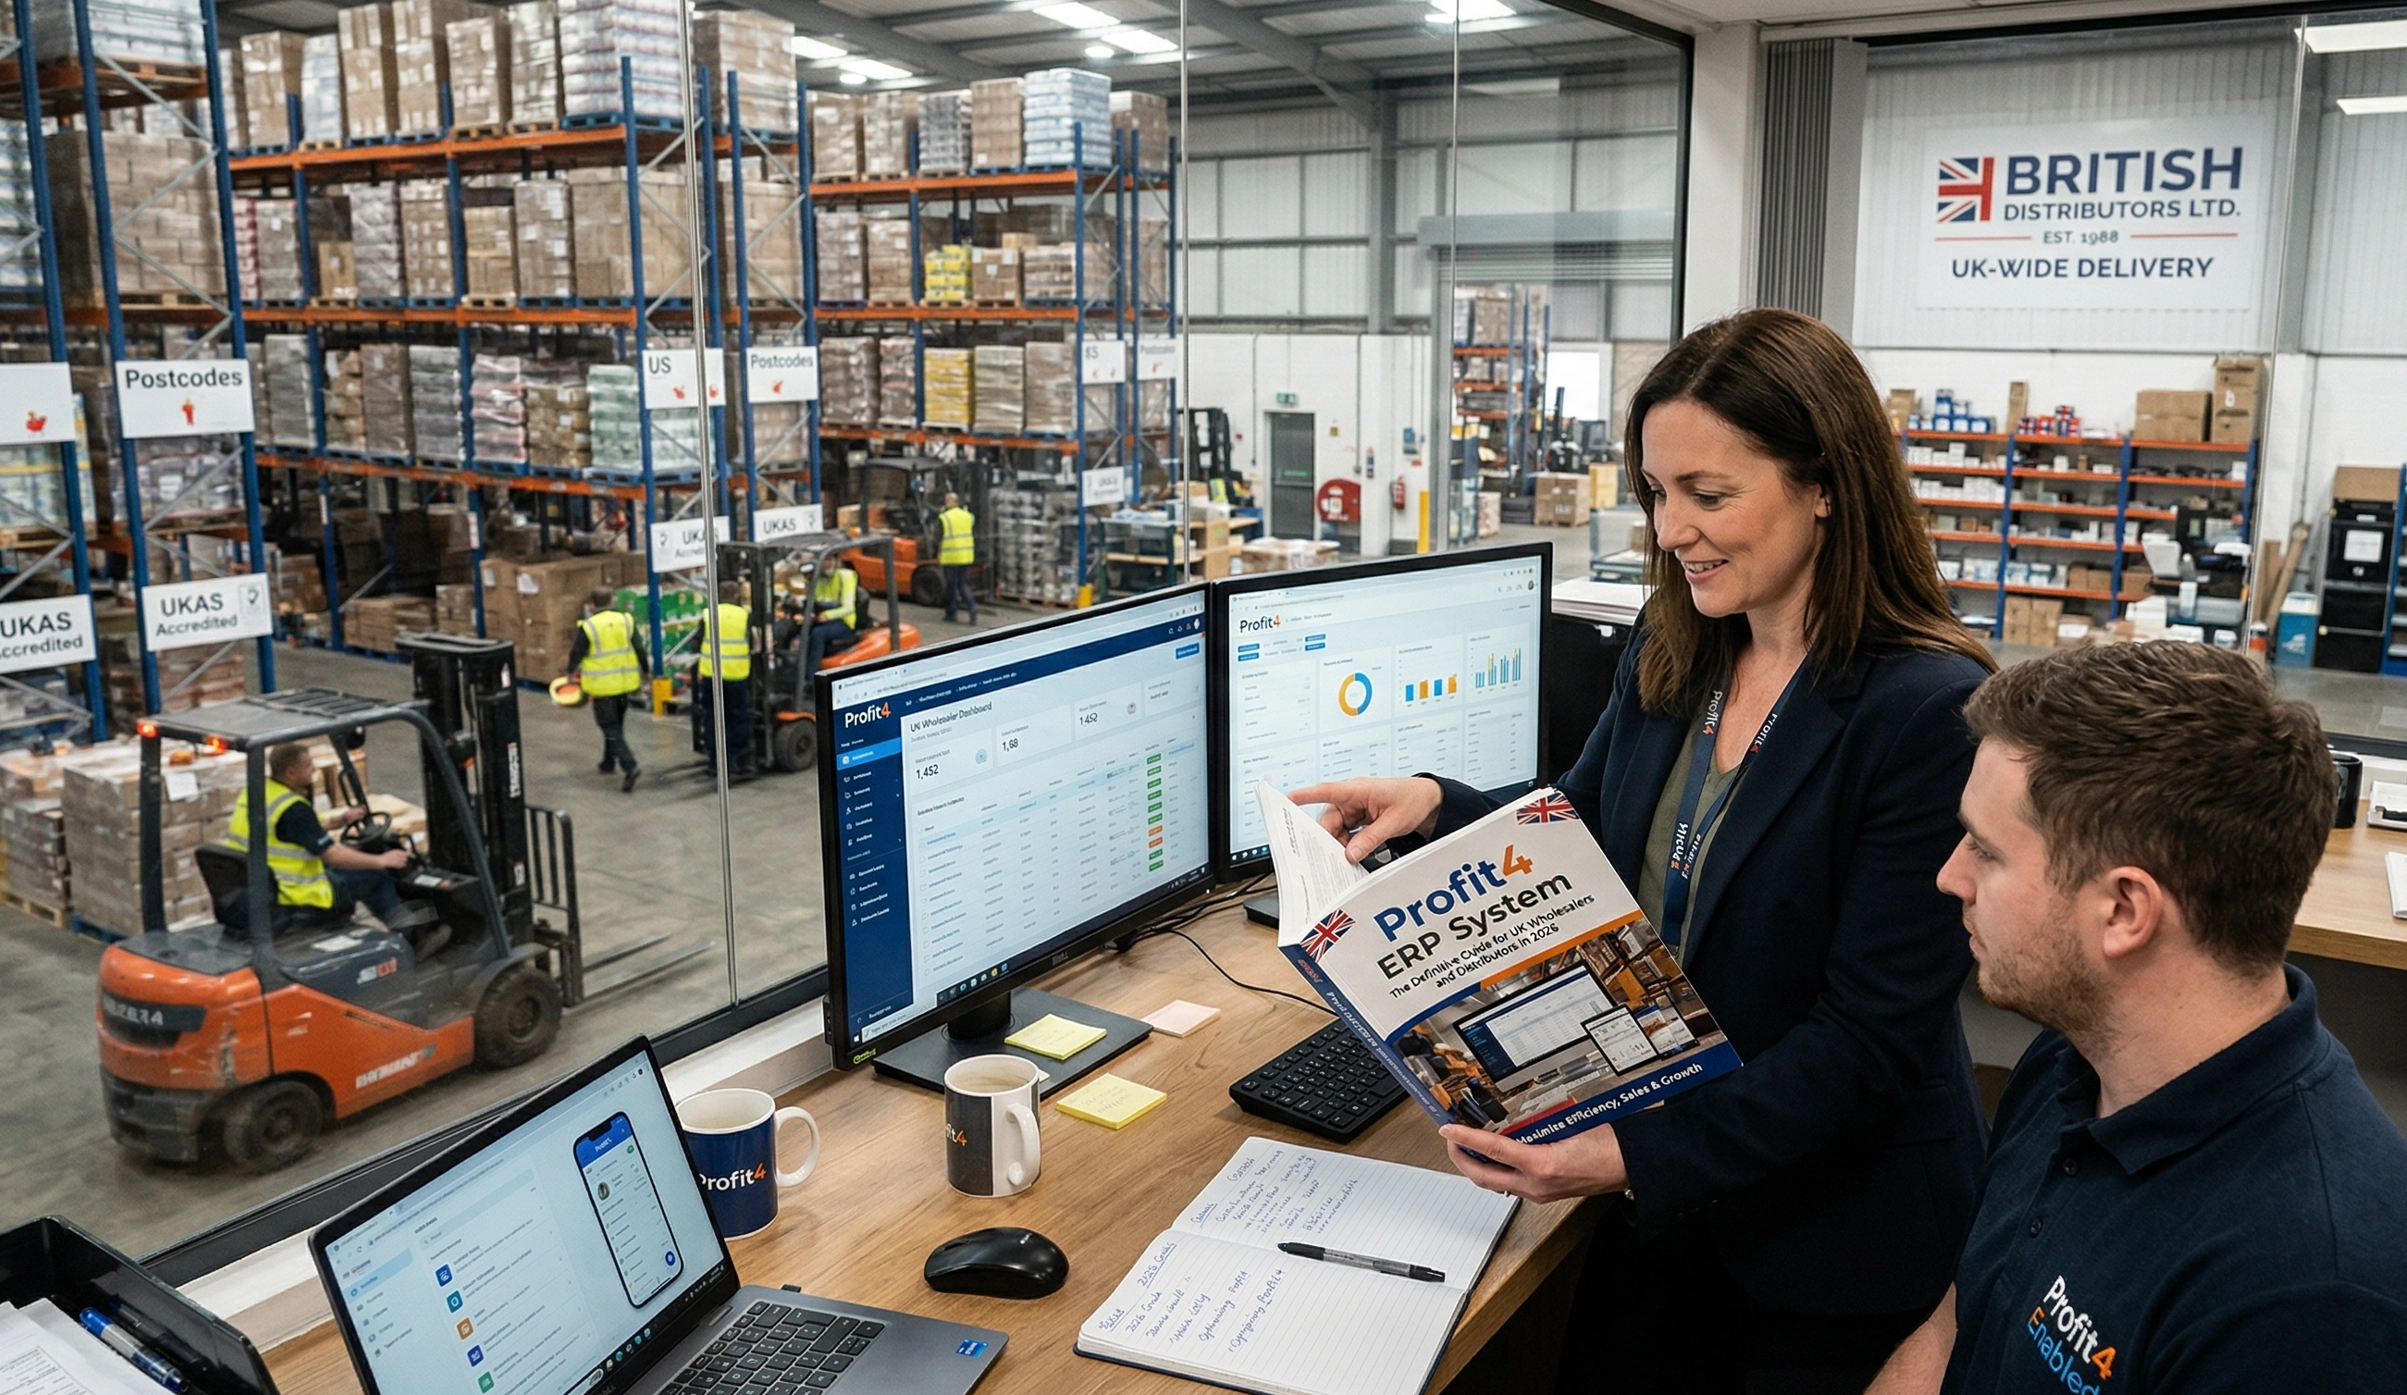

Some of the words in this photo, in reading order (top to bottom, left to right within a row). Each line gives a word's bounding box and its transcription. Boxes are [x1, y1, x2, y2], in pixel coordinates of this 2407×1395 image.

[2006, 146, 2243, 195] BRITISH
[2004, 199, 2181, 221] DISTRIBUTORS
[2189, 198, 2241, 217] LTD.
[2043, 231, 2076, 245] EST.
[2081, 230, 2119, 244] 1988
[1952, 258, 2068, 278] UK-WIDE
[2077, 257, 2214, 278] DELIVERY
[648, 356, 671, 374] US
[750, 354, 813, 369] Postcodes
[125, 367, 243, 389] Postcodes
[763, 518, 796, 535] UKAS
[160, 593, 224, 617] UKAS
[0, 611, 72, 638] UKAS
[156, 614, 238, 637] Accredited
[1239, 614, 1281, 633] Profit4
[0, 634, 84, 659] ccredited
[844, 702, 892, 728] Profit4
[916, 763, 939, 780] 1,452
[1372, 844, 1534, 943] Profit4
[1376, 931, 1441, 980] ERP
[1448, 873, 1572, 942] System
[1389, 982, 1411, 999] The
[1492, 931, 1509, 945] for
[1508, 921, 1527, 937] UK
[1525, 894, 1595, 936] Wholesalers
[1435, 970, 1457, 988] and
[1529, 922, 1559, 942] 2026
[1619, 1085, 1650, 1103] Sales
[1650, 1079, 1661, 1090] &
[1660, 1063, 1703, 1086] Growth
[2043, 1275, 2116, 1380] Profit4
